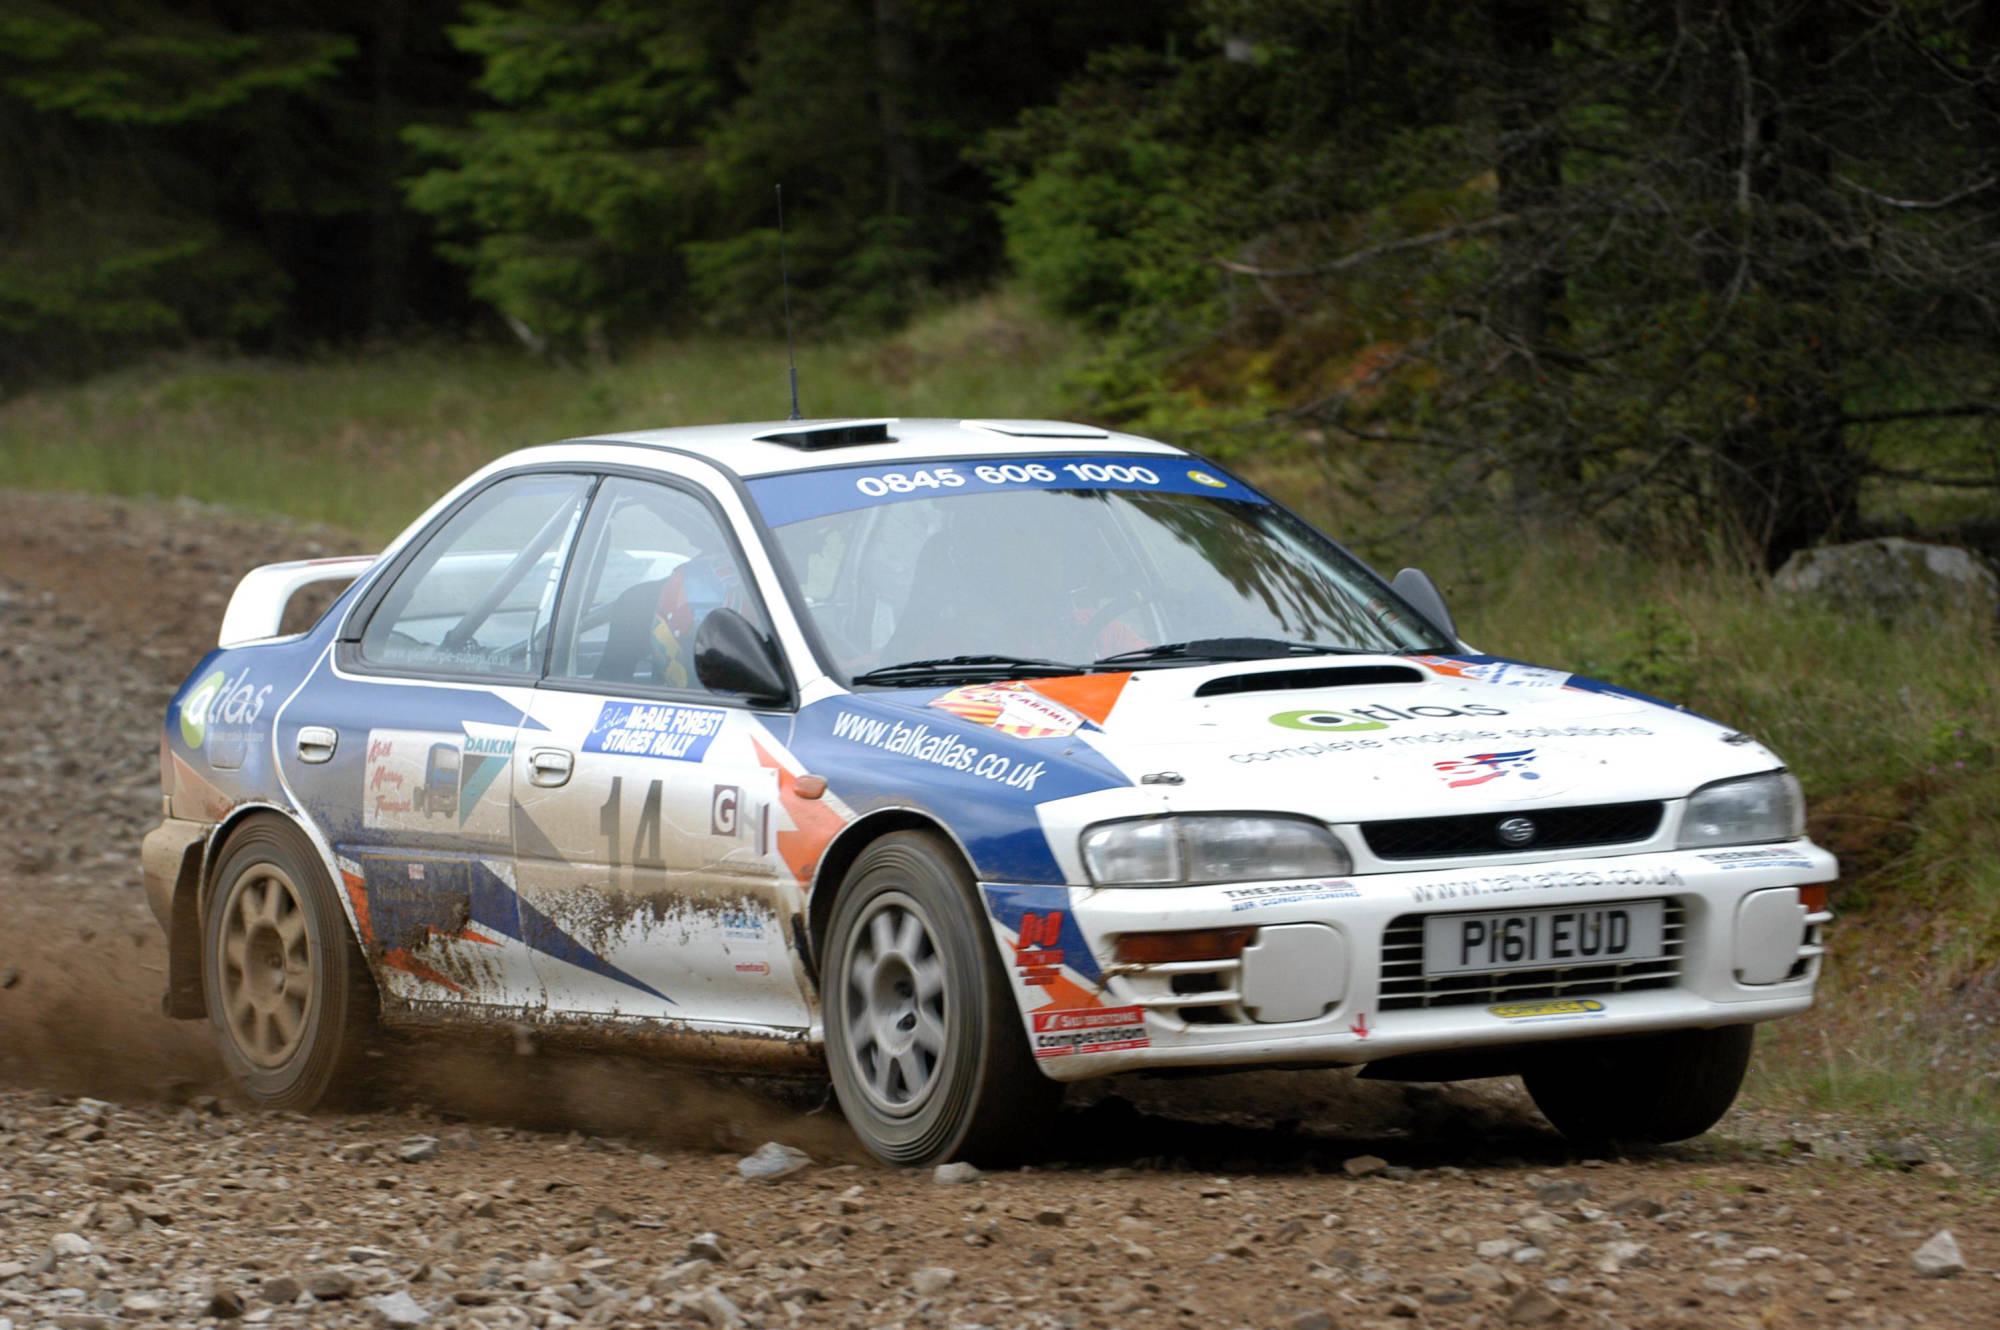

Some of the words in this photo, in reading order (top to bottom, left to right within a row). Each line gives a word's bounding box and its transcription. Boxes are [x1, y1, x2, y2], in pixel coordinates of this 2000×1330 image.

[856, 468, 966, 498] 0845
[974, 463, 1057, 485] 606
[1063, 463, 1161, 486] 1000
[184, 667, 273, 730] atlas
[592, 706, 628, 734] Colin
[624, 704, 675, 732] McRAE
[669, 708, 725, 737] FOREST
[1269, 703, 1510, 732] atlas
[464, 737, 515, 754] DAIKIN
[601, 728, 657, 755] STAGES
[649, 732, 698, 759] RALLY
[832, 711, 1047, 791] www.talkatlas.co.uk
[1229, 736, 1384, 765] complete
[1390, 727, 1502, 747] mobile
[1506, 721, 1655, 739] solutions
[600, 776, 667, 891] 14
[1410, 866, 1685, 903] www.talkatlas.co.uk
[1460, 915, 1538, 966] P161
[1550, 909, 1630, 959] EUD
